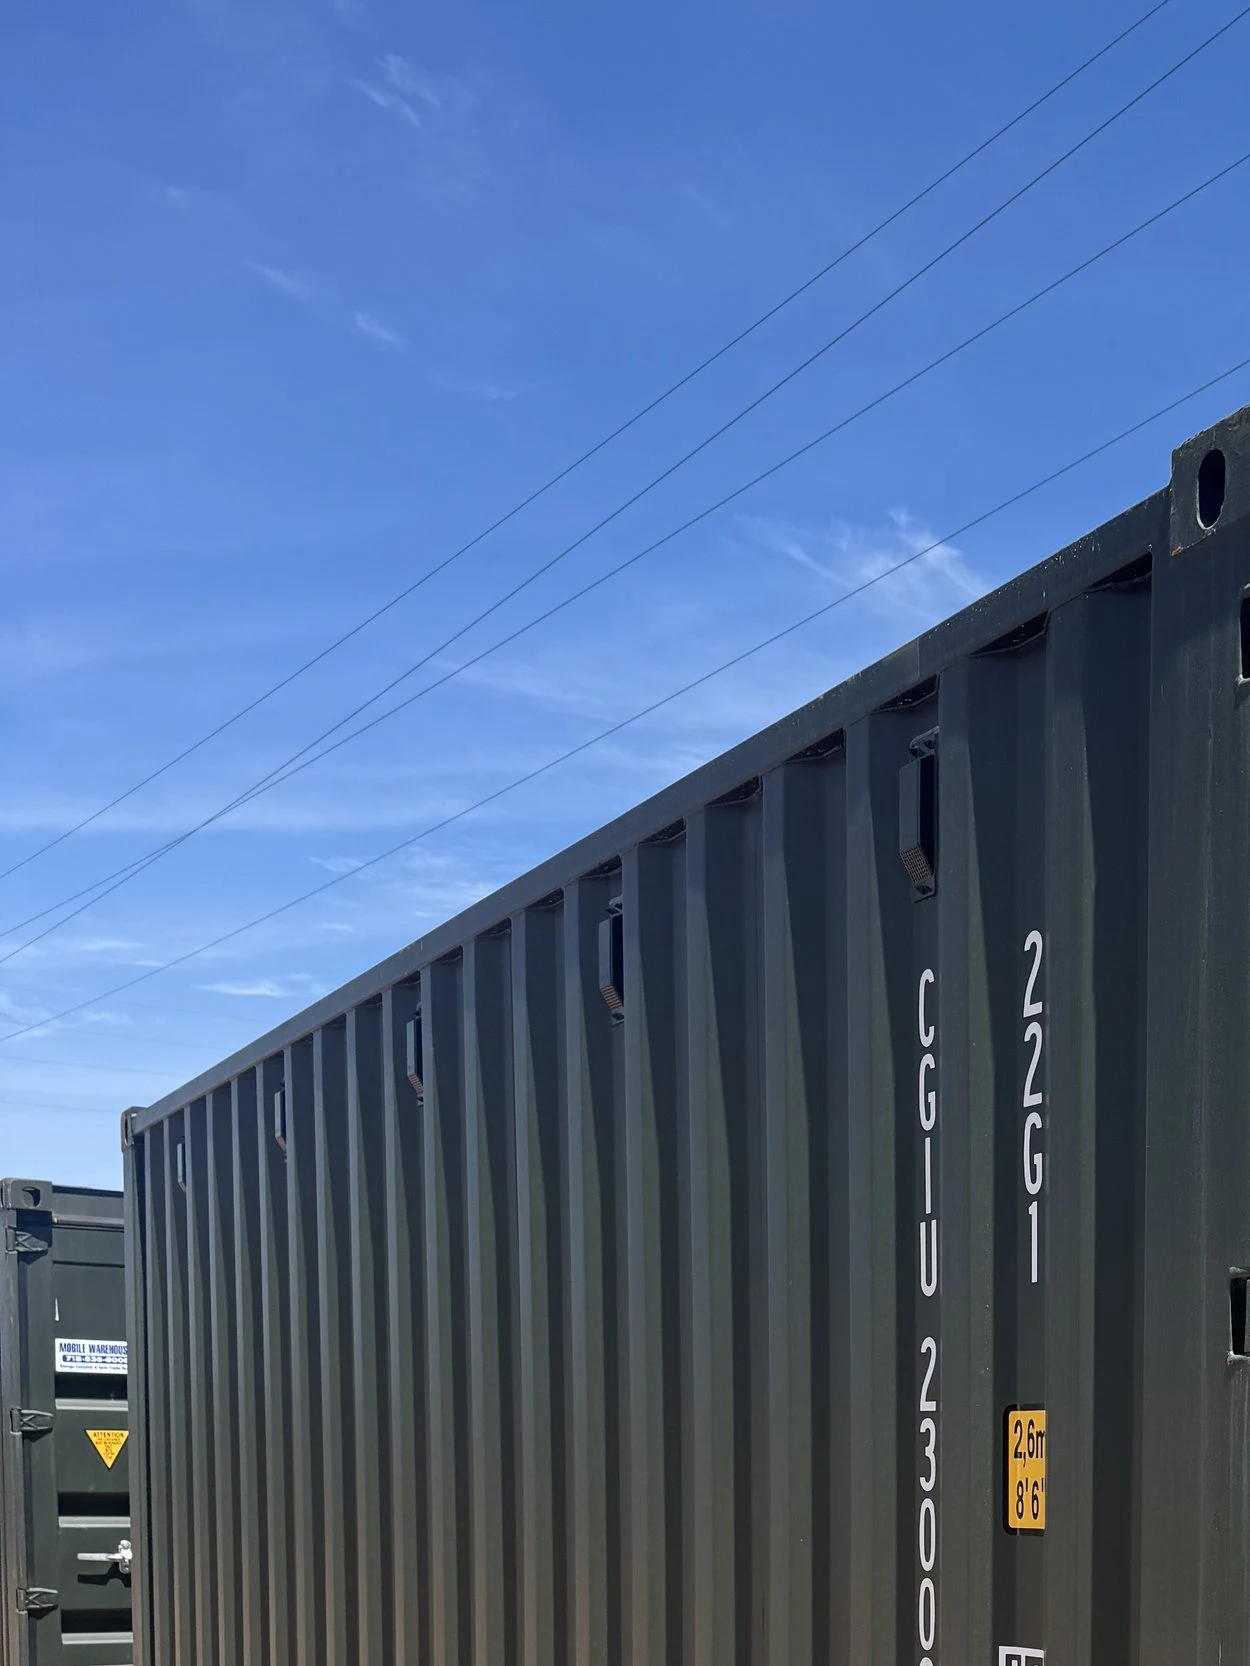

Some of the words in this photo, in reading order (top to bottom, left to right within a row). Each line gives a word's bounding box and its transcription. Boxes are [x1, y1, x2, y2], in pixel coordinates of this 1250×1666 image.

[918, 968, 938, 1297] CGIU
[1023, 930, 1043, 1283] 22G1
[59, 1343, 86, 1353] MOBILE
